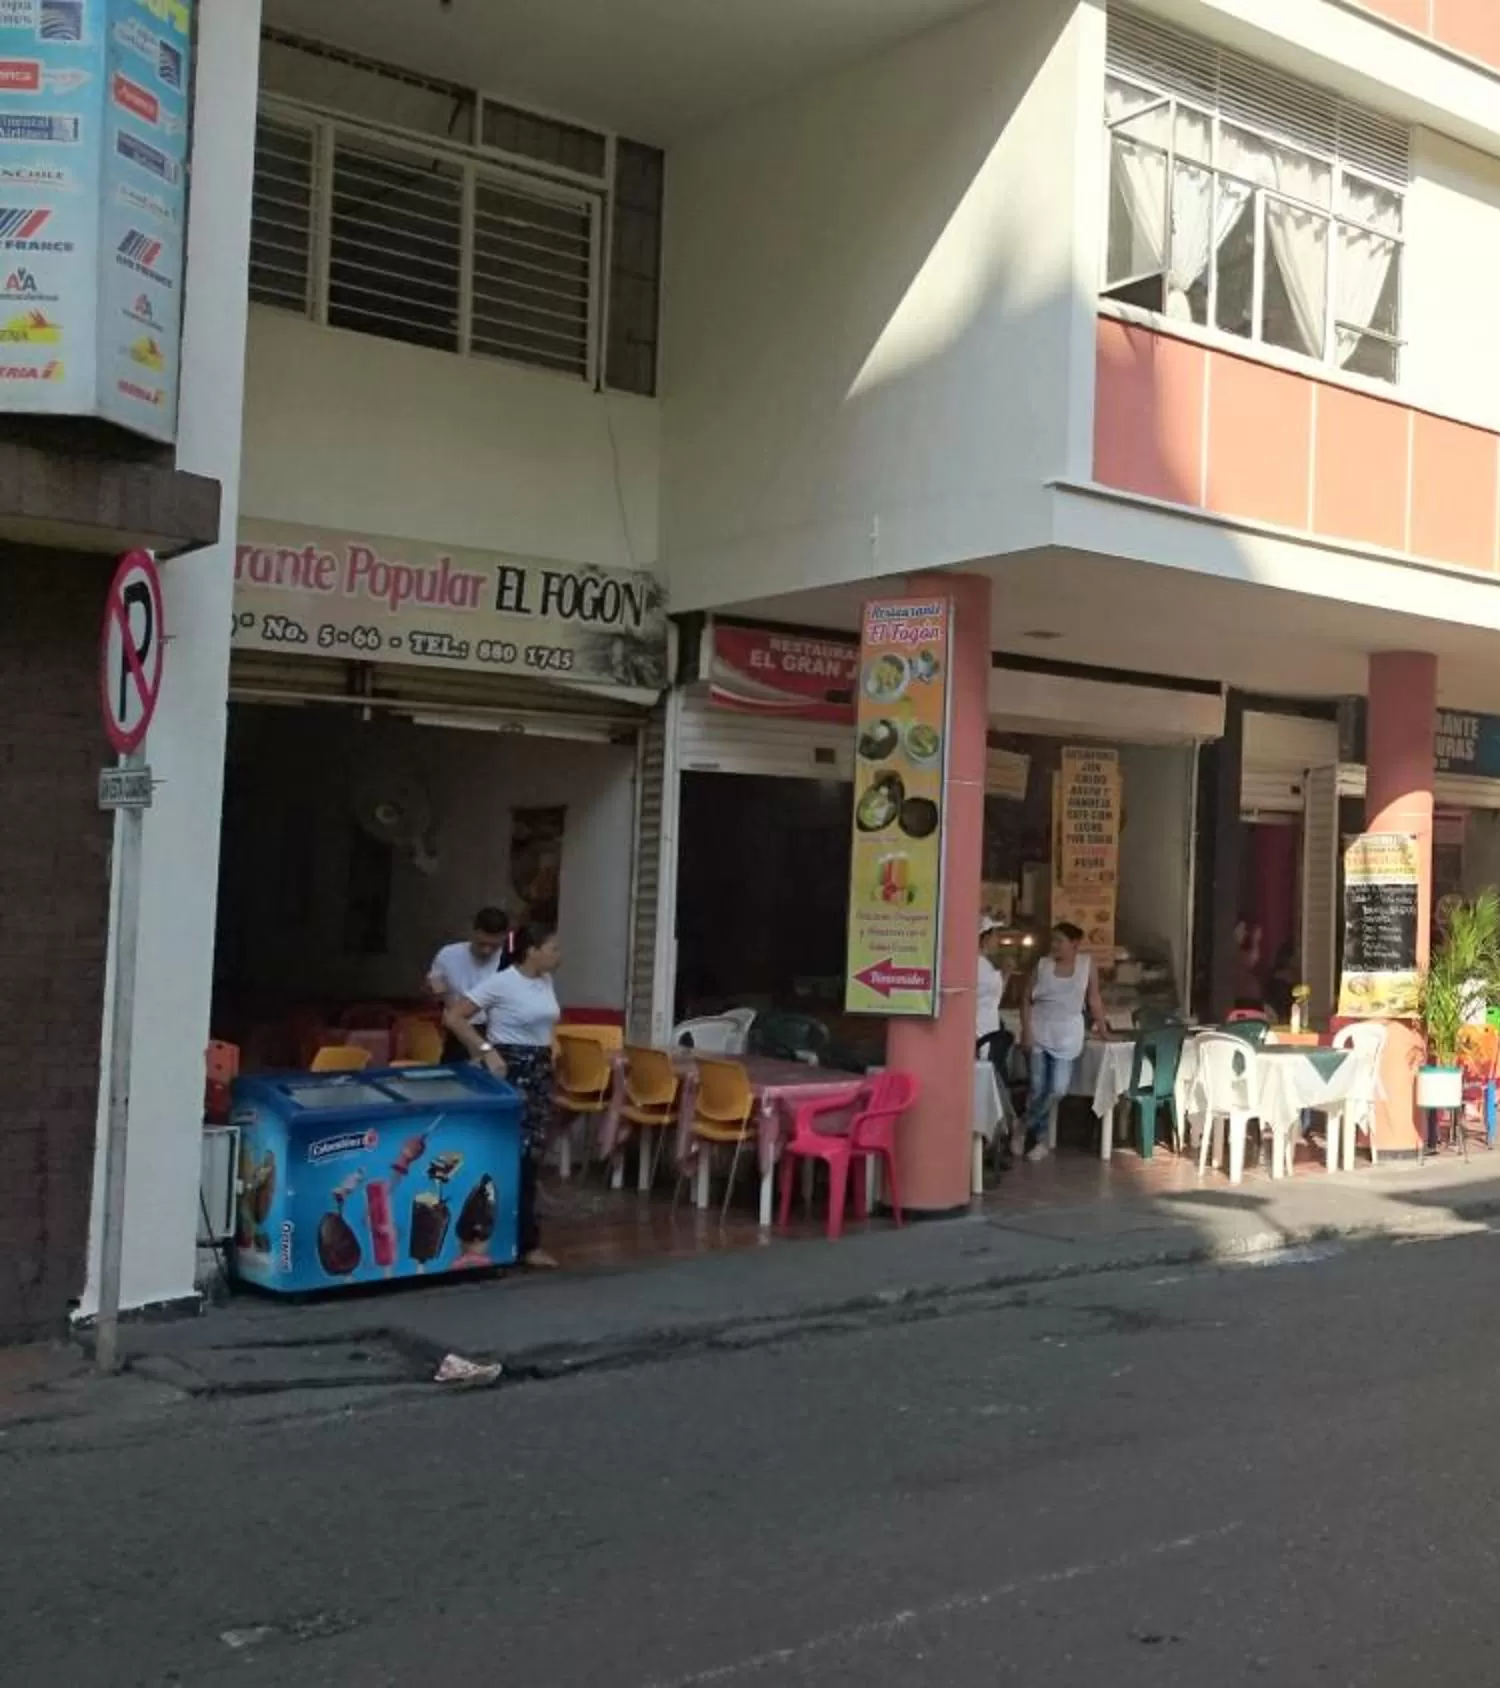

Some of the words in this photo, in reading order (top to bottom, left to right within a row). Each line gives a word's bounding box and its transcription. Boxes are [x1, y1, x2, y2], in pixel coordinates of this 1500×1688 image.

[5, 240, 74, 252] FRANCE
[346, 545, 487, 612] Popular
[496, 564, 532, 615] EL
[262, 615, 308, 643] No.
[525, 646, 574, 670] 1745
[750, 648, 777, 669] EL
[781, 653, 842, 679] GRAN
